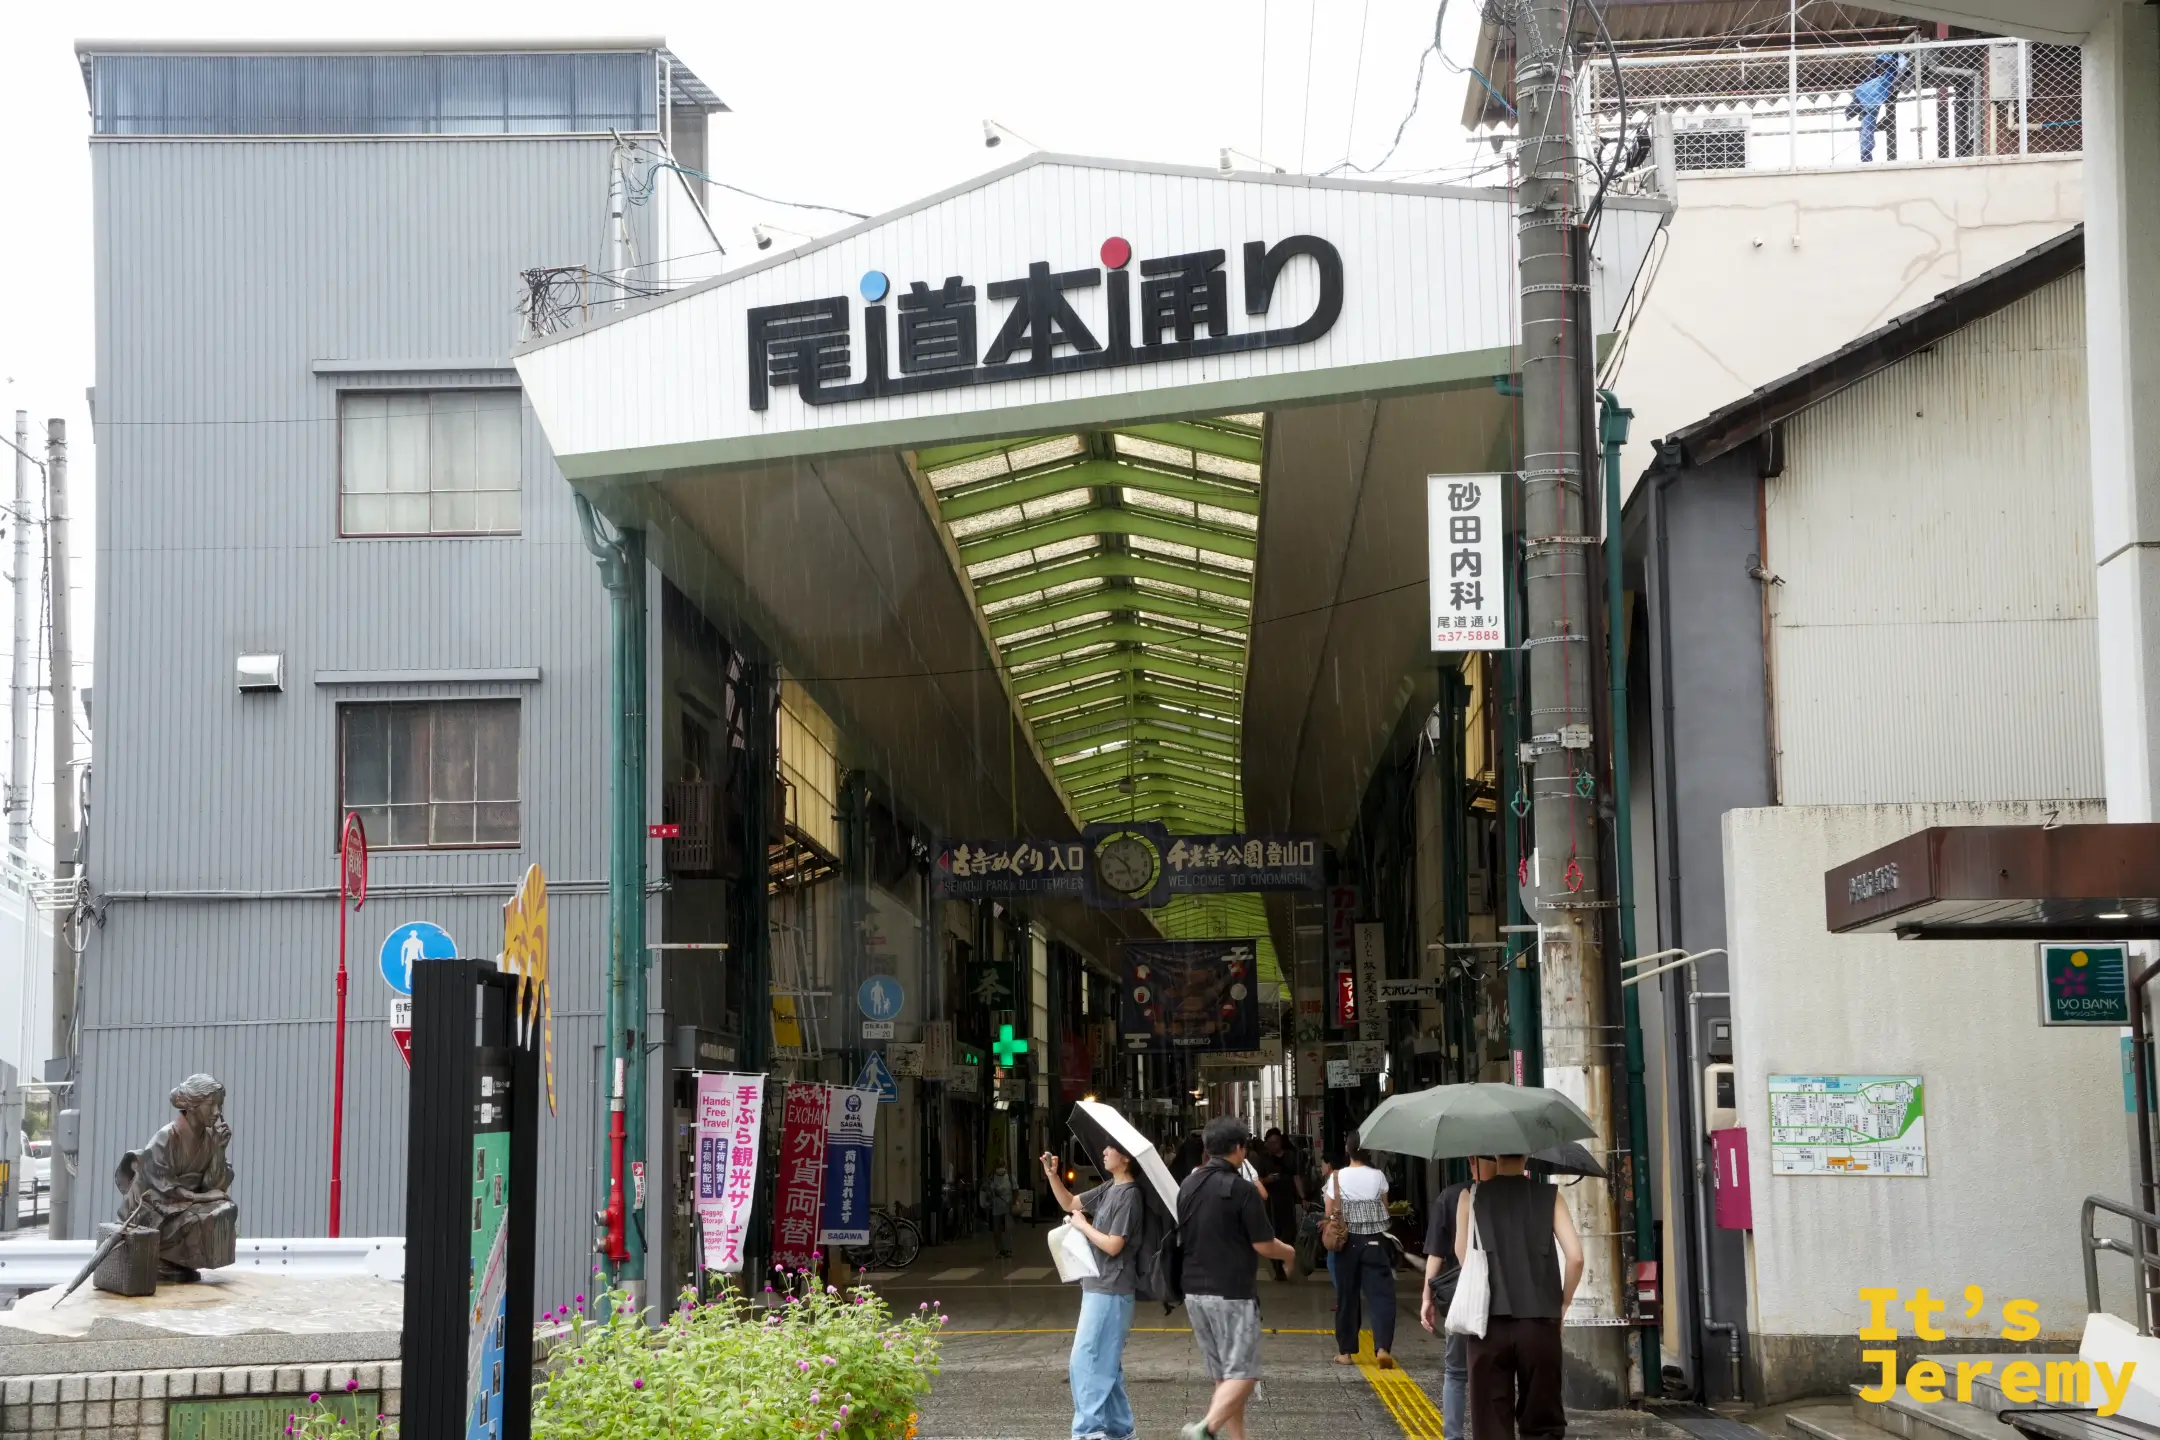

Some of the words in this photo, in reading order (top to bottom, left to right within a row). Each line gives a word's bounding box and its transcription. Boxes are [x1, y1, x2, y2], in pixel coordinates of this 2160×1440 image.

[748, 235, 1343, 411] 尾道本通り
[1448, 482, 1484, 610] 砂田内科
[1437, 615, 1498, 629] 尾道通り
[1447, 631, 1499, 642] 37-5888
[1166, 839, 1314, 872] 千光寺公園登山口
[945, 880, 982, 892] SENKOJI
[987, 880, 1008, 891] PARK
[1019, 878, 1038, 891] OLD
[1041, 877, 1084, 890] TEMPLES
[1168, 874, 1225, 887] WELCOME
[1231, 873, 1246, 886] TO
[1251, 872, 1307, 886] ONOMICHI
[2057, 997, 2080, 1009] IYO
[2082, 998, 2119, 1009] BANK
[702, 1096, 731, 1106] Hands
[706, 1107, 726, 1117] Free
[702, 1118, 730, 1128] Travel
[702, 1140, 713, 1194] 手荷物配送
[722, 1085, 758, 1263] 手ぶら観光サービス
[781, 1129, 825, 1246] 外貨両替
[840, 1149, 857, 1224] 荷物送れます
[827, 1232, 863, 1240] SAGAWA
